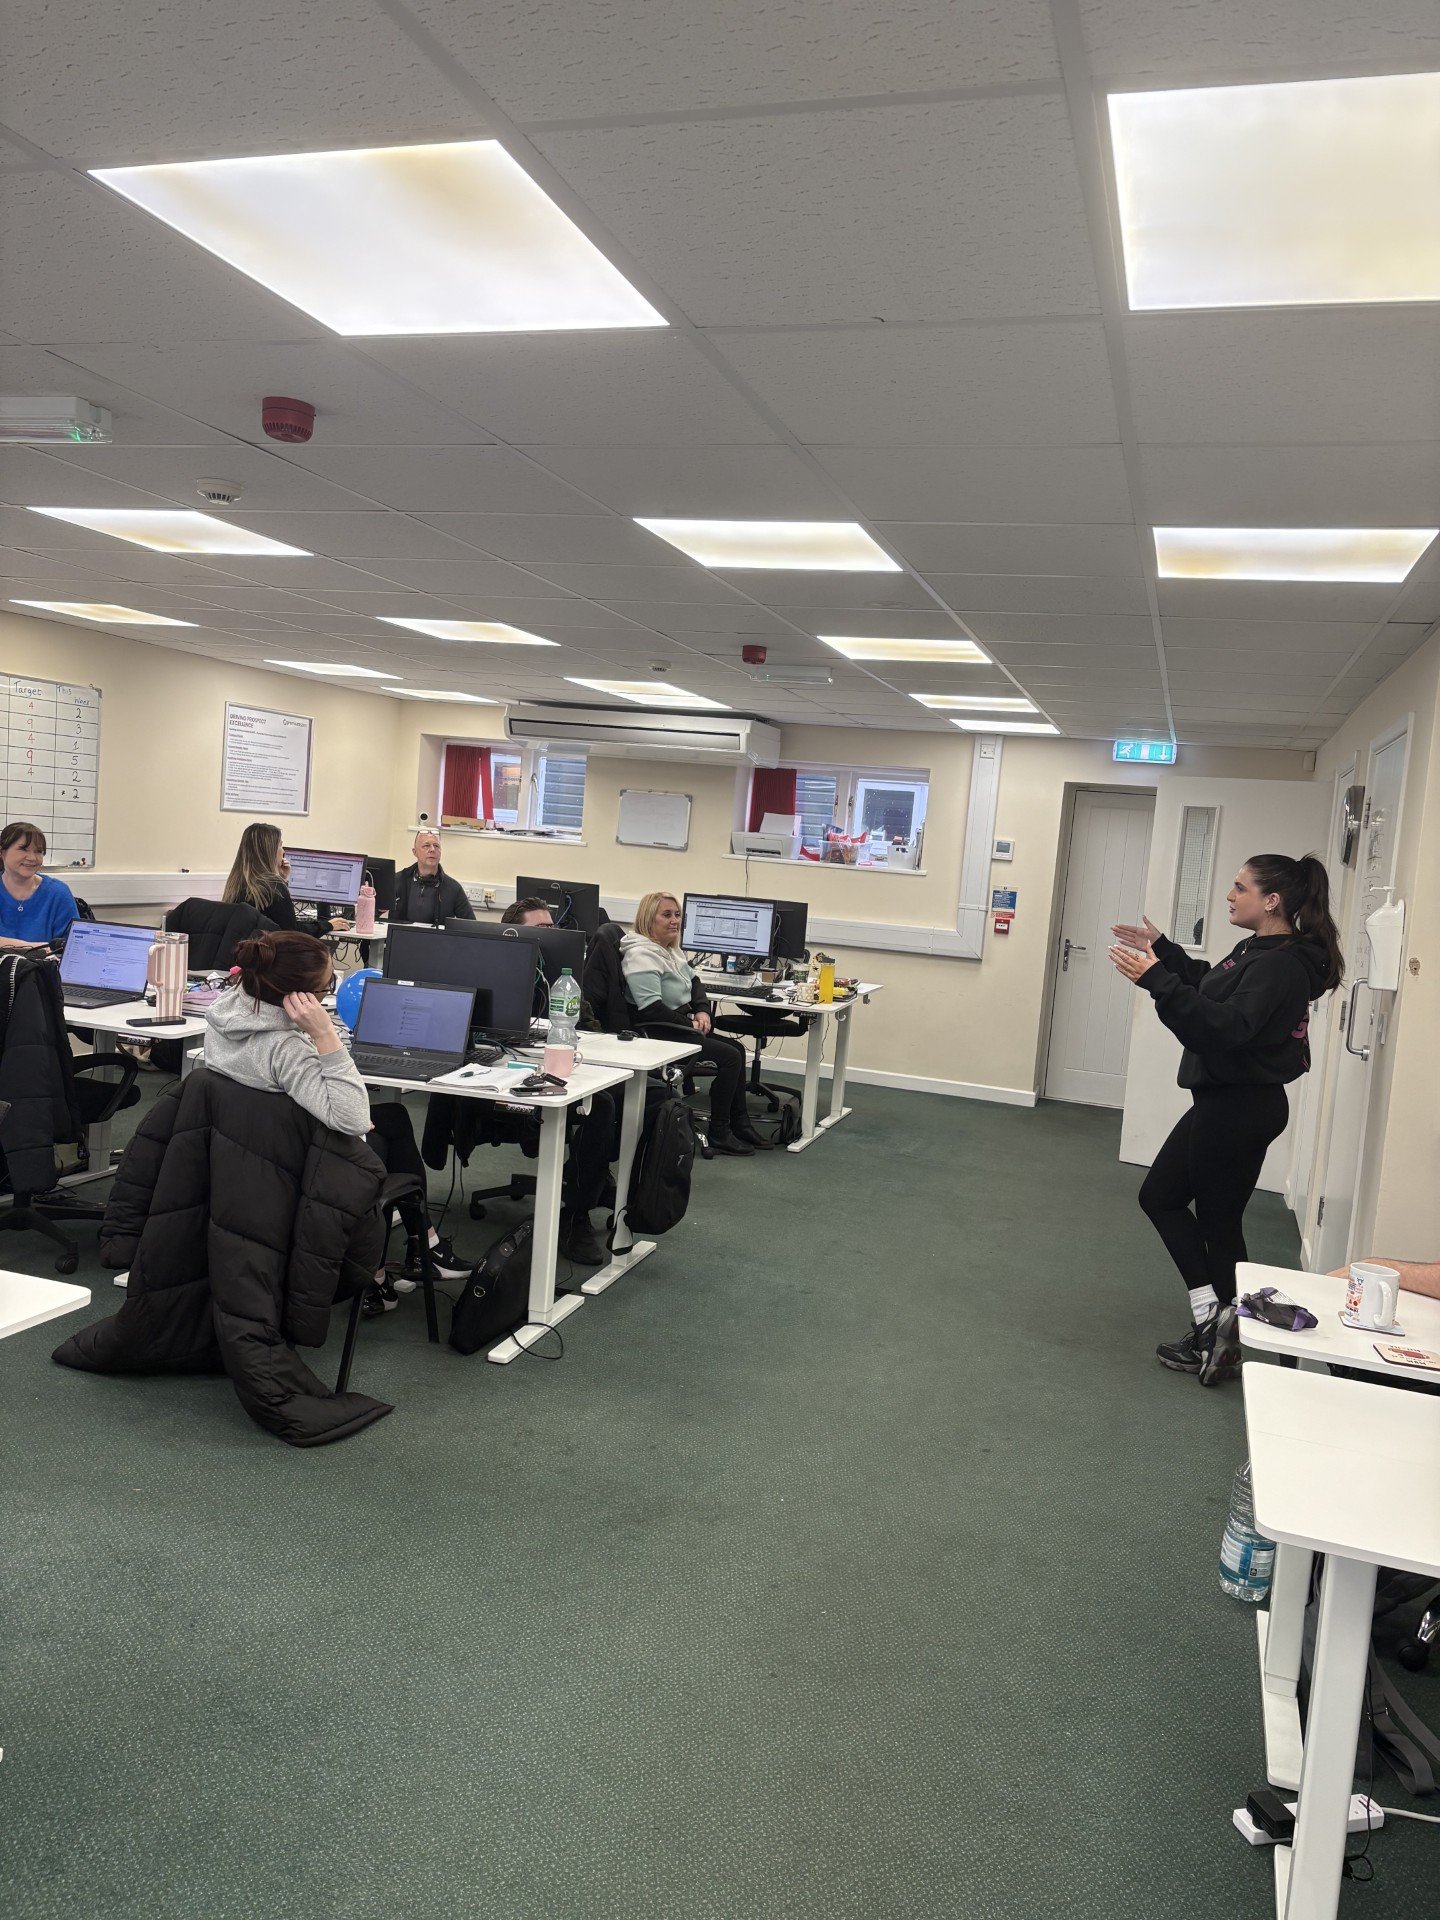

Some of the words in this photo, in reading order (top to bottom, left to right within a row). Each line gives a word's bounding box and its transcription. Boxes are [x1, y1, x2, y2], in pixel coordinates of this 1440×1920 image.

[14, 680, 42, 698] Target
[28, 701, 34, 709] 4
[75, 708, 82, 718] 2
[76, 723, 82, 734] 3
[28, 733, 35, 744] 4
[26, 750, 33, 764] 9
[71, 755, 79, 765] 5
[28, 767, 34, 776] 4
[72, 771, 81, 782] 2
[73, 788, 79, 799] 2
